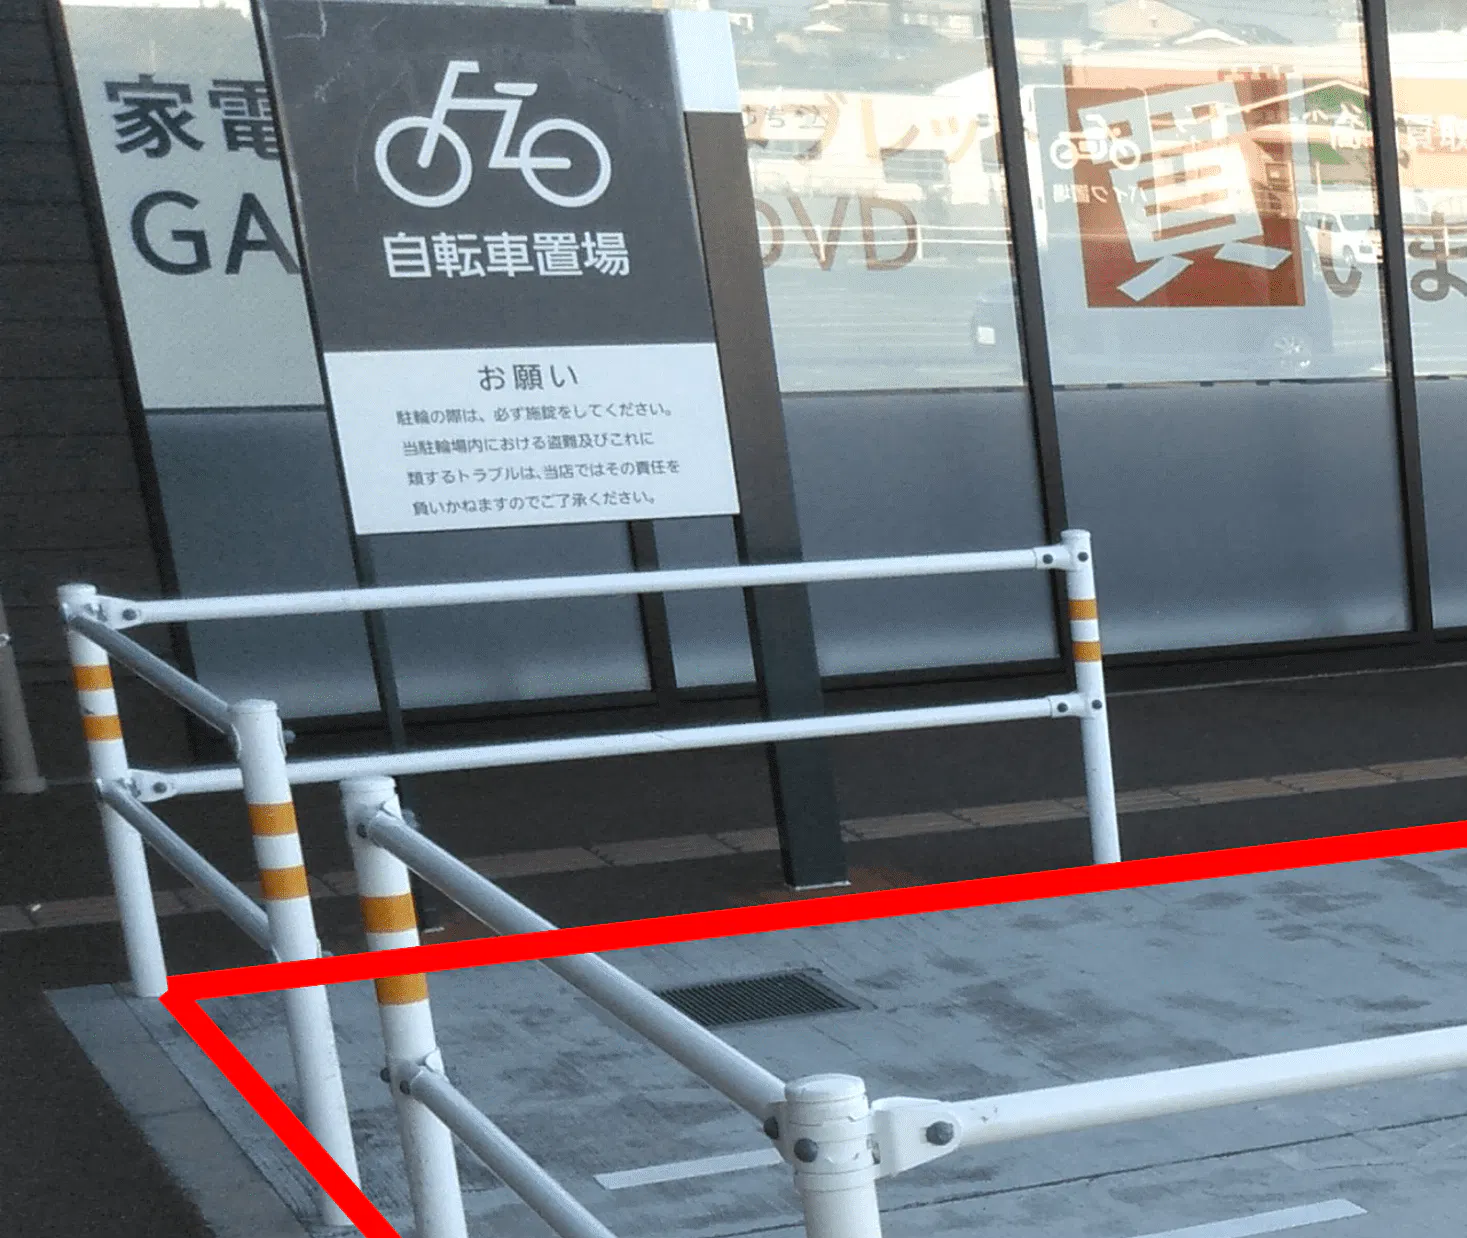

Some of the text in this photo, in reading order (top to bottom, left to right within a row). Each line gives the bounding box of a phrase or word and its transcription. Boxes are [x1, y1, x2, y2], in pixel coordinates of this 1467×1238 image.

[383, 231, 630, 277] 自転車置場
[477, 363, 578, 391] お願い
[402, 431, 654, 457] 当駐輪場内における盗難及びこれに
[413, 490, 656, 517] 負いかねますのでご了承ください。
